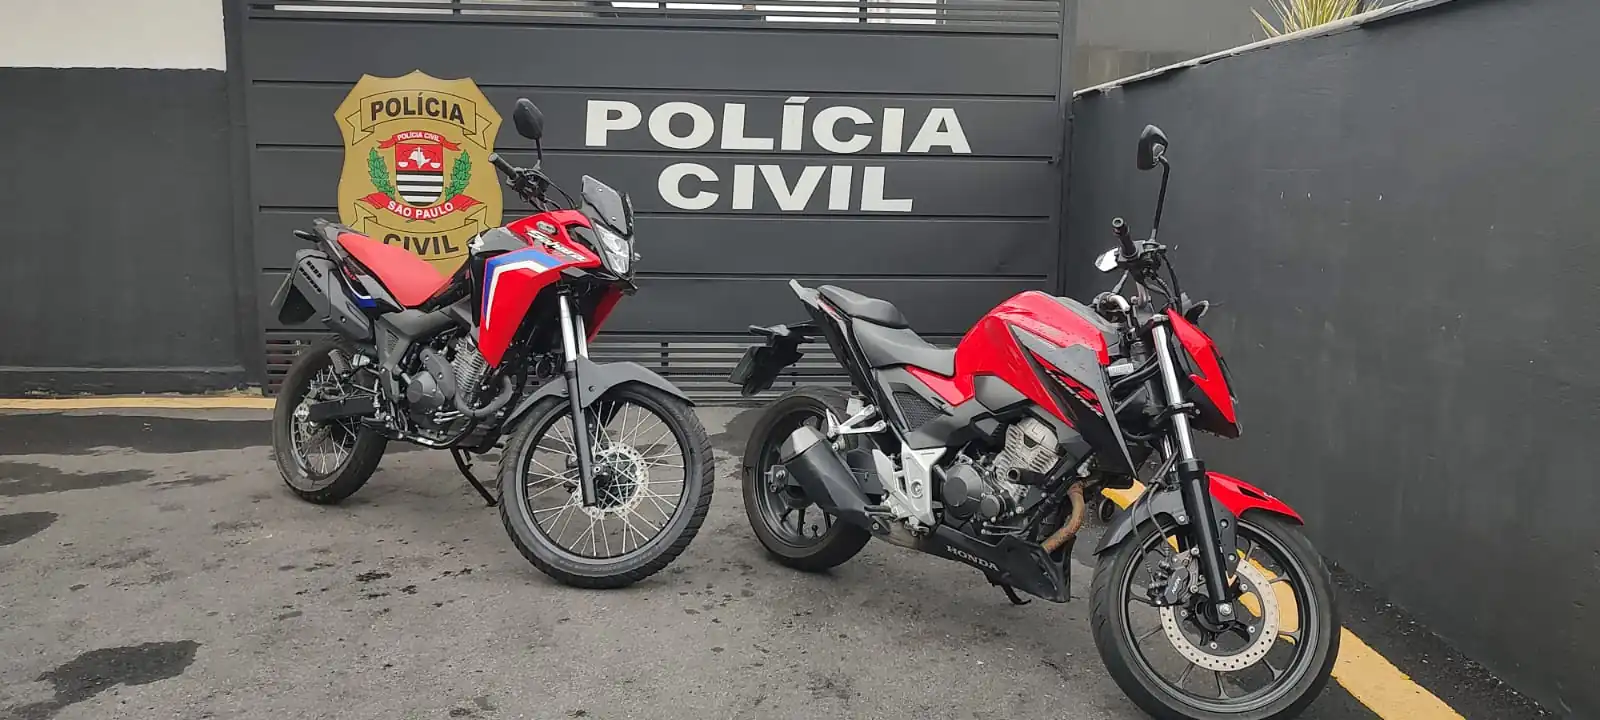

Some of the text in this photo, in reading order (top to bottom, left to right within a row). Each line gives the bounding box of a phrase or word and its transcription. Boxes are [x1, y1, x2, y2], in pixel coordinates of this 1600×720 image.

[371, 92, 465, 125] POLÍCIA
[424, 133, 441, 142] CIVIL
[585, 96, 972, 154] POLÍCIA
[658, 162, 913, 212] CIVIL
[415, 202, 454, 219] PAULO
[945, 545, 1000, 572] HONDA
